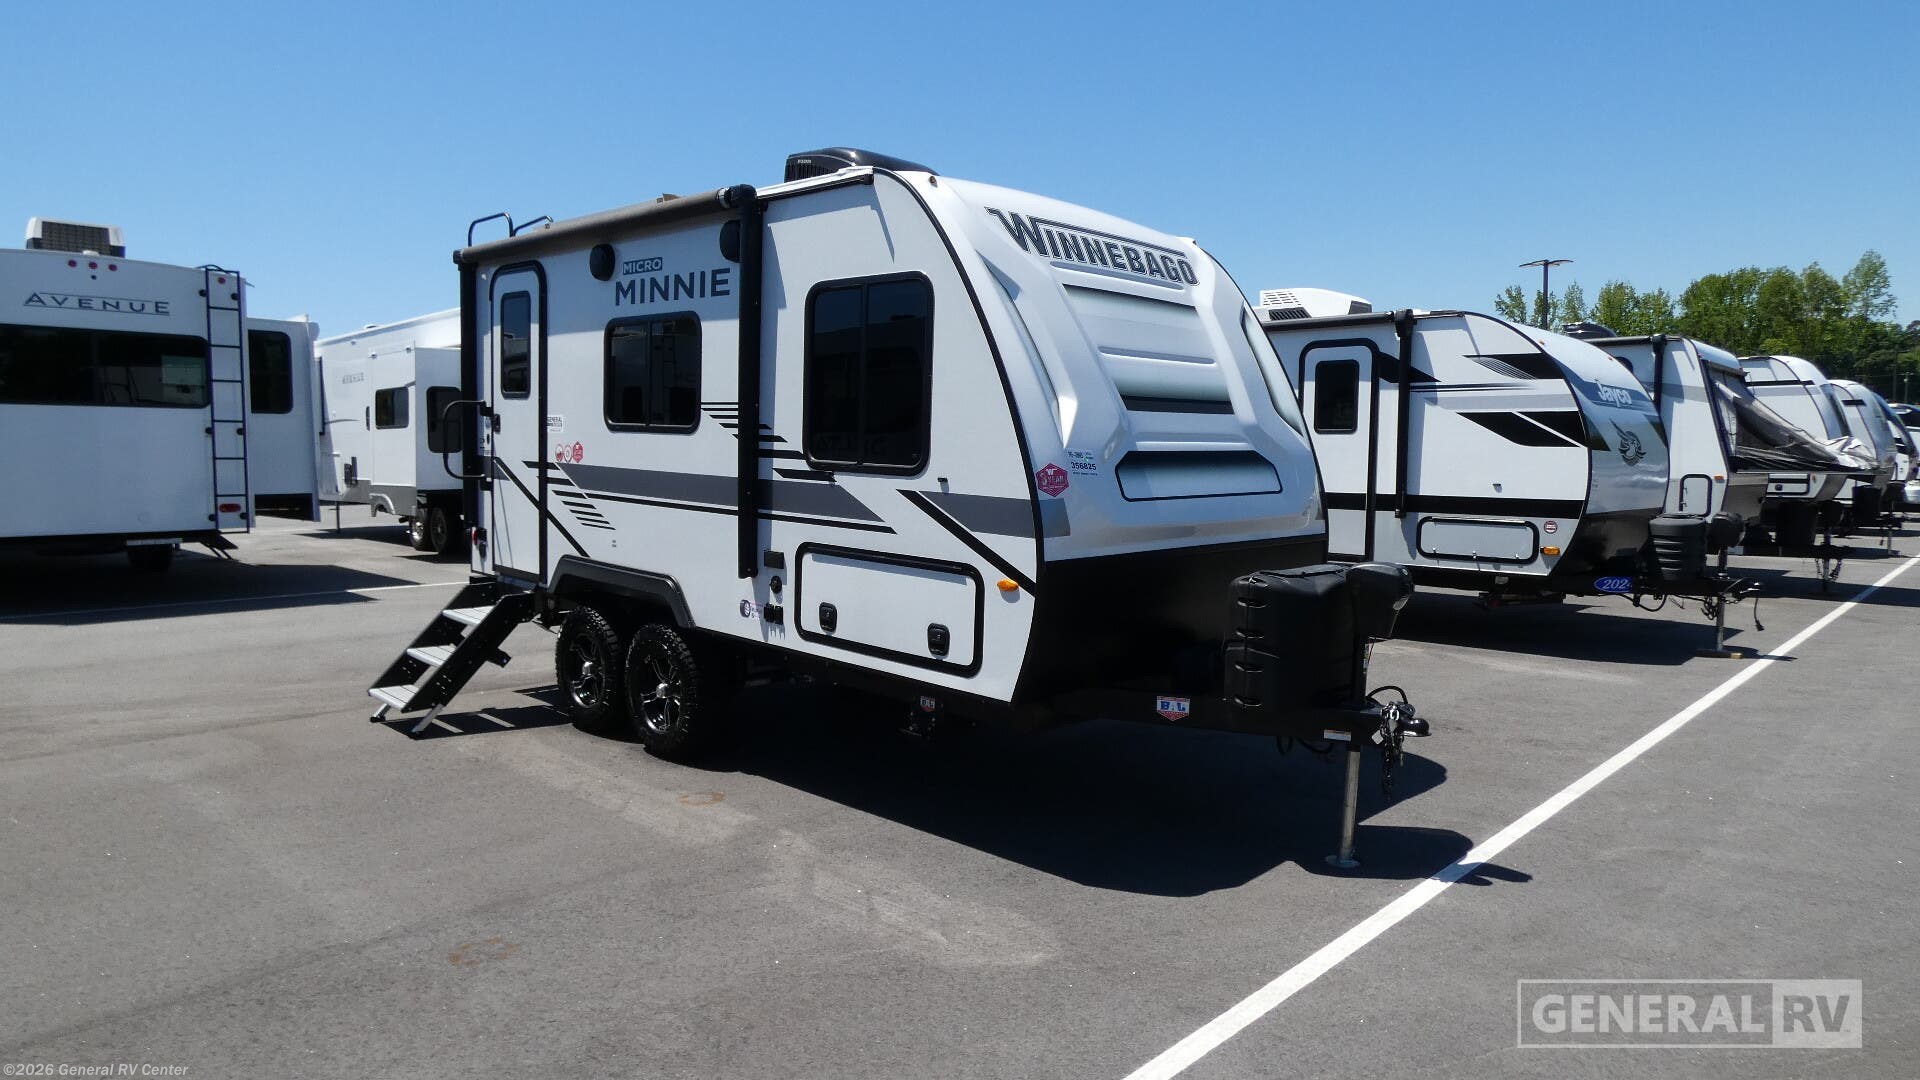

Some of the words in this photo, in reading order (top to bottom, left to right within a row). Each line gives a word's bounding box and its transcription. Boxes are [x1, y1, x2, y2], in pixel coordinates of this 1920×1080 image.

[984, 206, 1199, 286] WINNEBAGO
[623, 258, 663, 275] MICRO
[615, 267, 731, 306] MINNIE
[24, 292, 170, 316] AVENUE
[1596, 381, 1633, 408] Jayco
